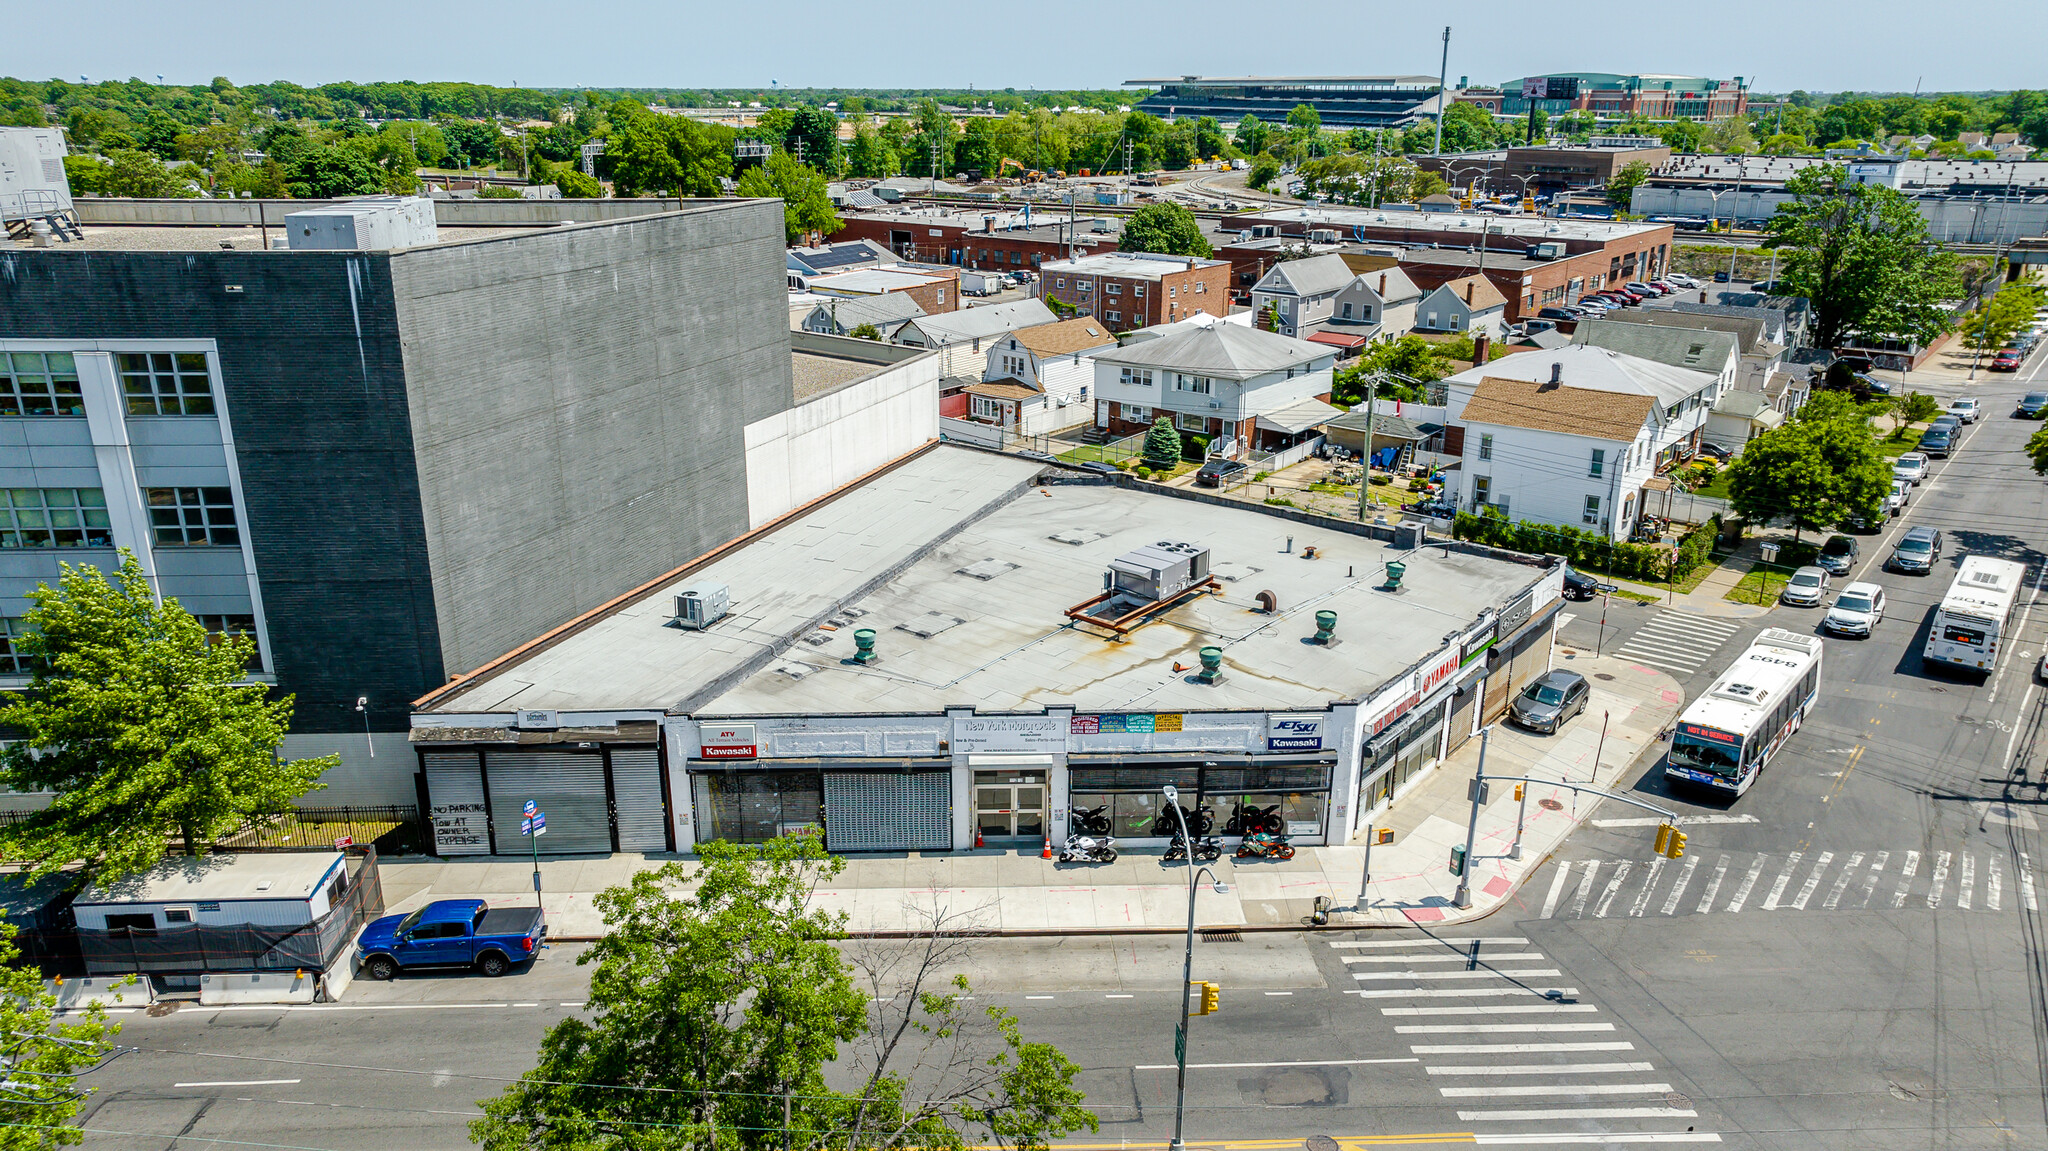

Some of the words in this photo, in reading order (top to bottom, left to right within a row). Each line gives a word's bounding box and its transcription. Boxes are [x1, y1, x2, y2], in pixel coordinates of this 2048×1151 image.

[1466, 627, 1495, 656] Kawasaki
[1750, 654, 1798, 668] 8493
[1431, 655, 1458, 687] YAMAHA
[965, 720, 984, 731] New
[987, 720, 1007, 731] York
[1009, 720, 1057, 731] Motorcycle
[1687, 726, 1699, 734] NOT
[1709, 731, 1734, 742] SERVICE
[449, 804, 486, 814] PARKING
[455, 818, 467, 826] AT
[437, 836, 480, 845] EXPENSE
